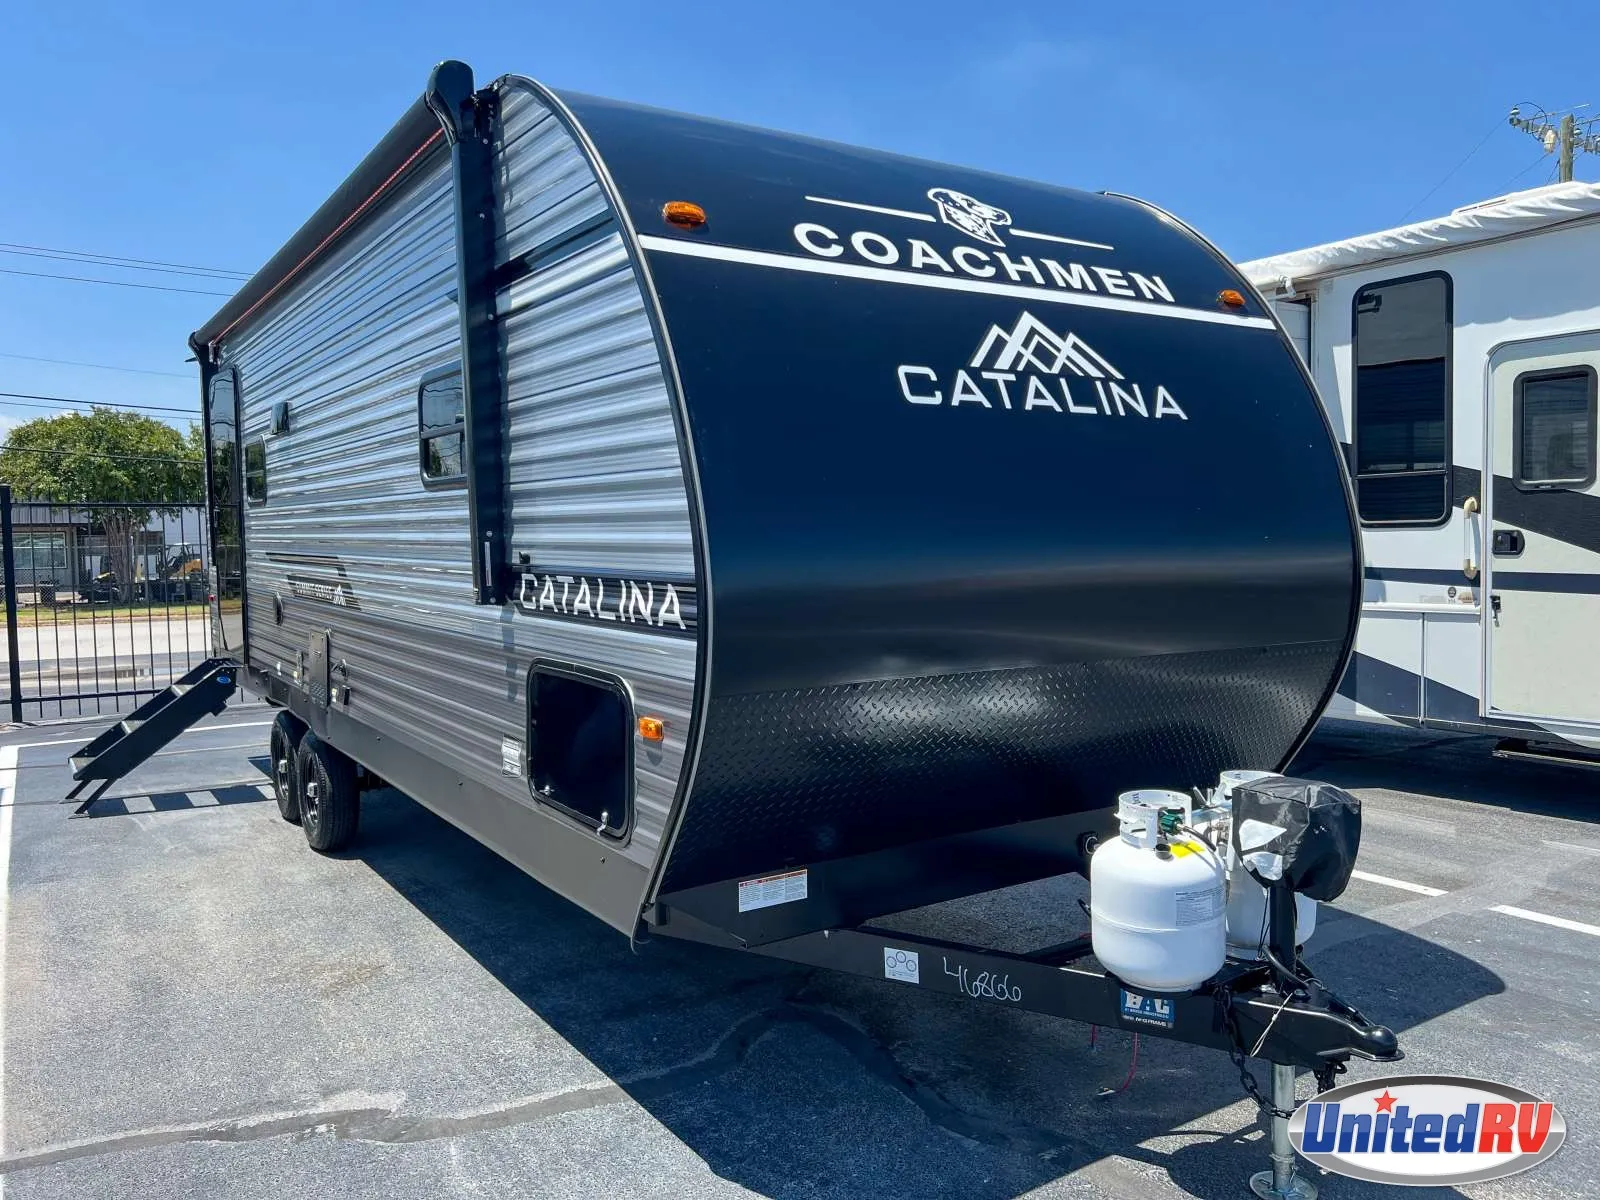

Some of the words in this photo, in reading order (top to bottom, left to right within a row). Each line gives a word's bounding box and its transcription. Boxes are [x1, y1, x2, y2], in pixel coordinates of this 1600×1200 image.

[793, 222, 1175, 303] COACHMEN
[898, 364, 1188, 420] CATALINA
[519, 573, 687, 630] CATALINA
[943, 956, 1022, 1002] 46866
